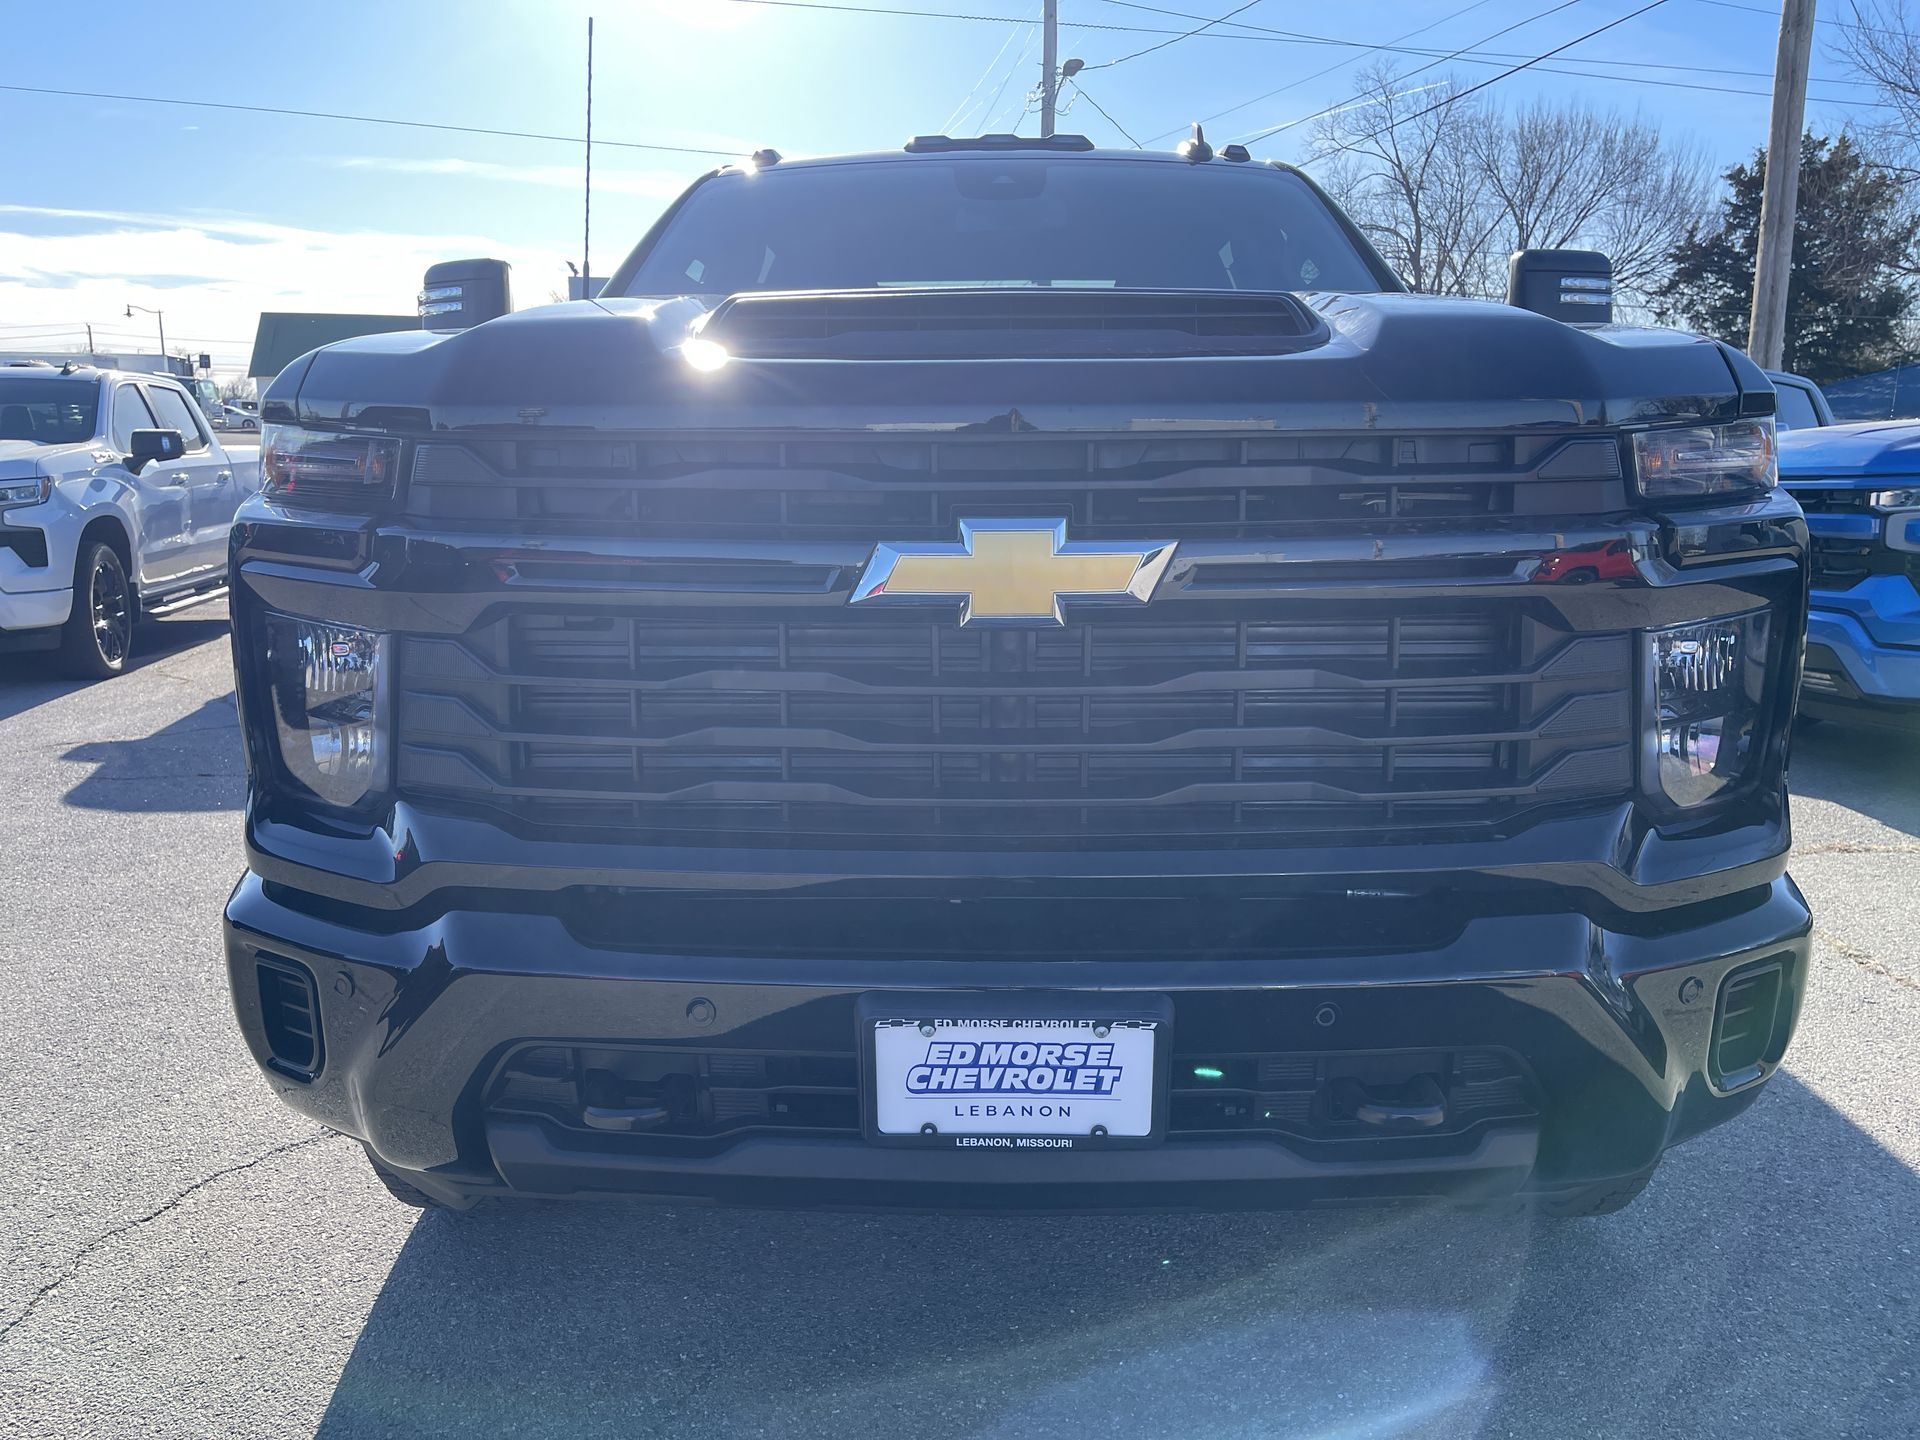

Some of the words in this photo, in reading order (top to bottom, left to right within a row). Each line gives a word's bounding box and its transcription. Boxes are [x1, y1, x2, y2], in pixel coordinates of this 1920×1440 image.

[934, 1019, 953, 1028] ED
[957, 1019, 1009, 1028] MORSE
[1012, 1019, 1096, 1029] CHEVROLET
[926, 1042, 978, 1065] ED
[978, 1042, 1115, 1067] MORSE
[906, 1065, 1123, 1095] CHEVROLET
[954, 1105, 1071, 1117] LEBANON
[956, 1138, 1014, 1148] LEBANON,
[1016, 1138, 1073, 1148] MISSOURI
